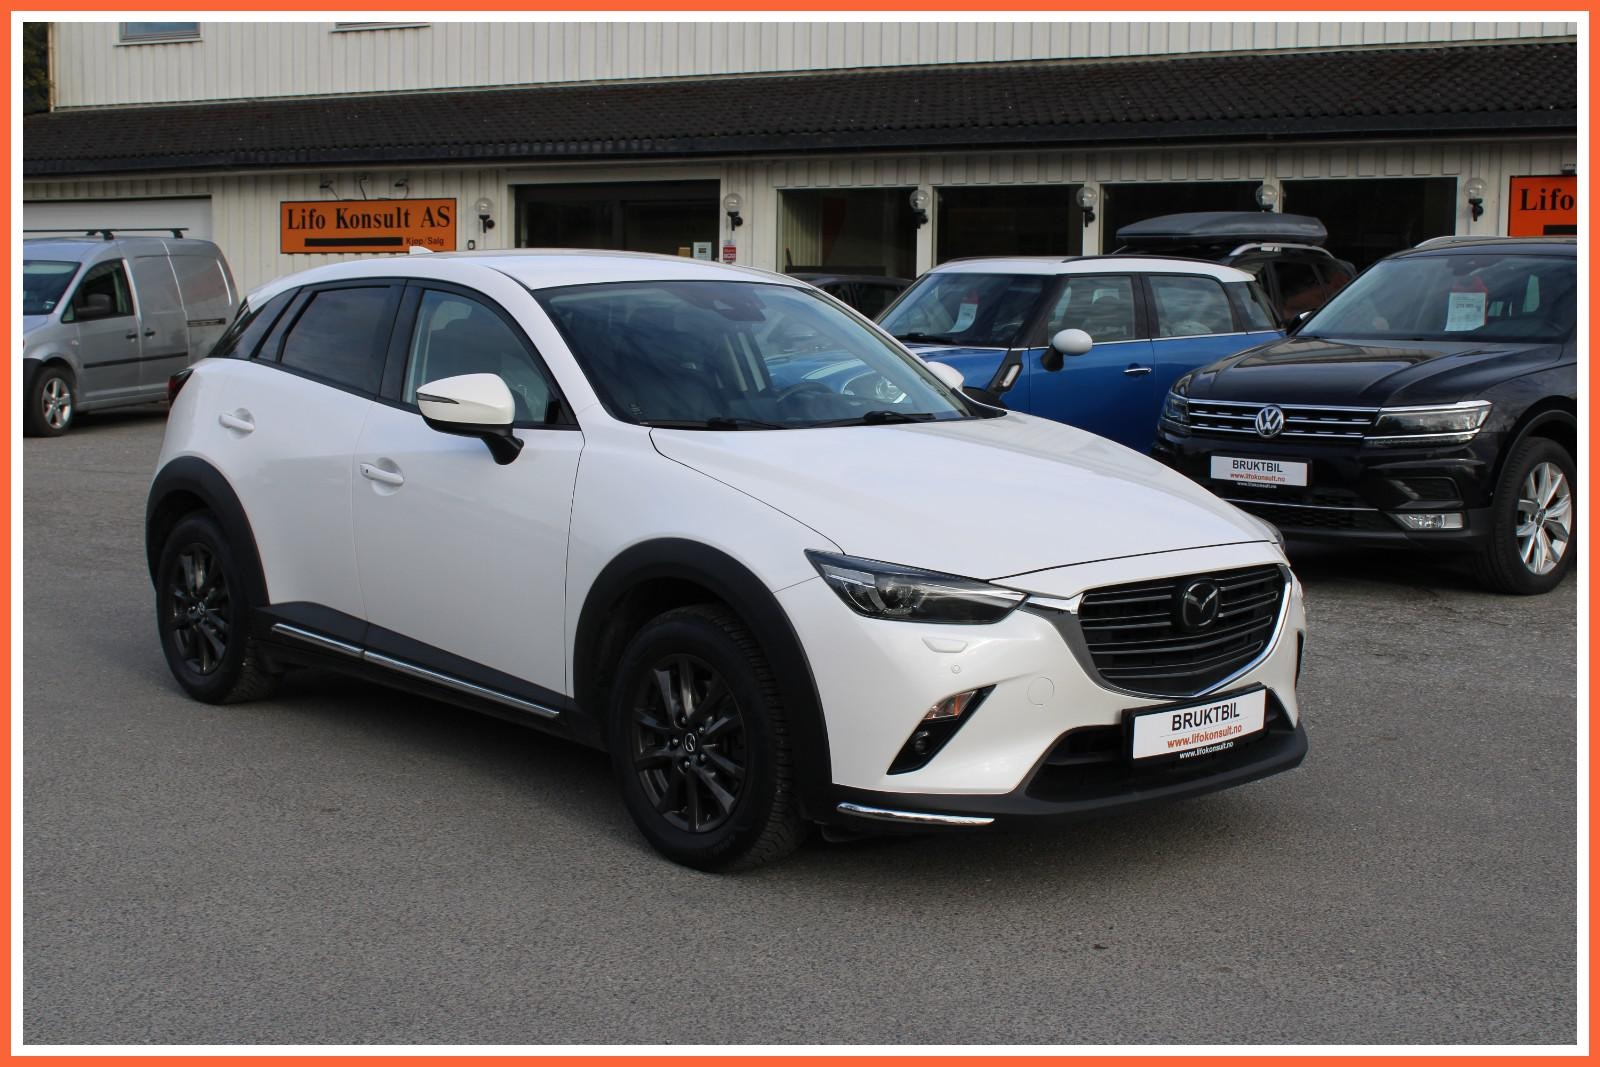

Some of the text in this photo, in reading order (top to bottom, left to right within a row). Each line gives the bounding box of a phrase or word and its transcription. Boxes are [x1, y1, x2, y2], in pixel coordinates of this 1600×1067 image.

[1520, 187, 1574, 211] Lifo
[287, 205, 450, 229] Lifo Konsult AS
[1232, 459, 1283, 473] BRUKTBIL
[1171, 702, 1240, 731] BRUKTBIL
[1167, 723, 1243, 749] www.lifokonsult.no
[1179, 740, 1235, 760] www.lifokonsult.no
